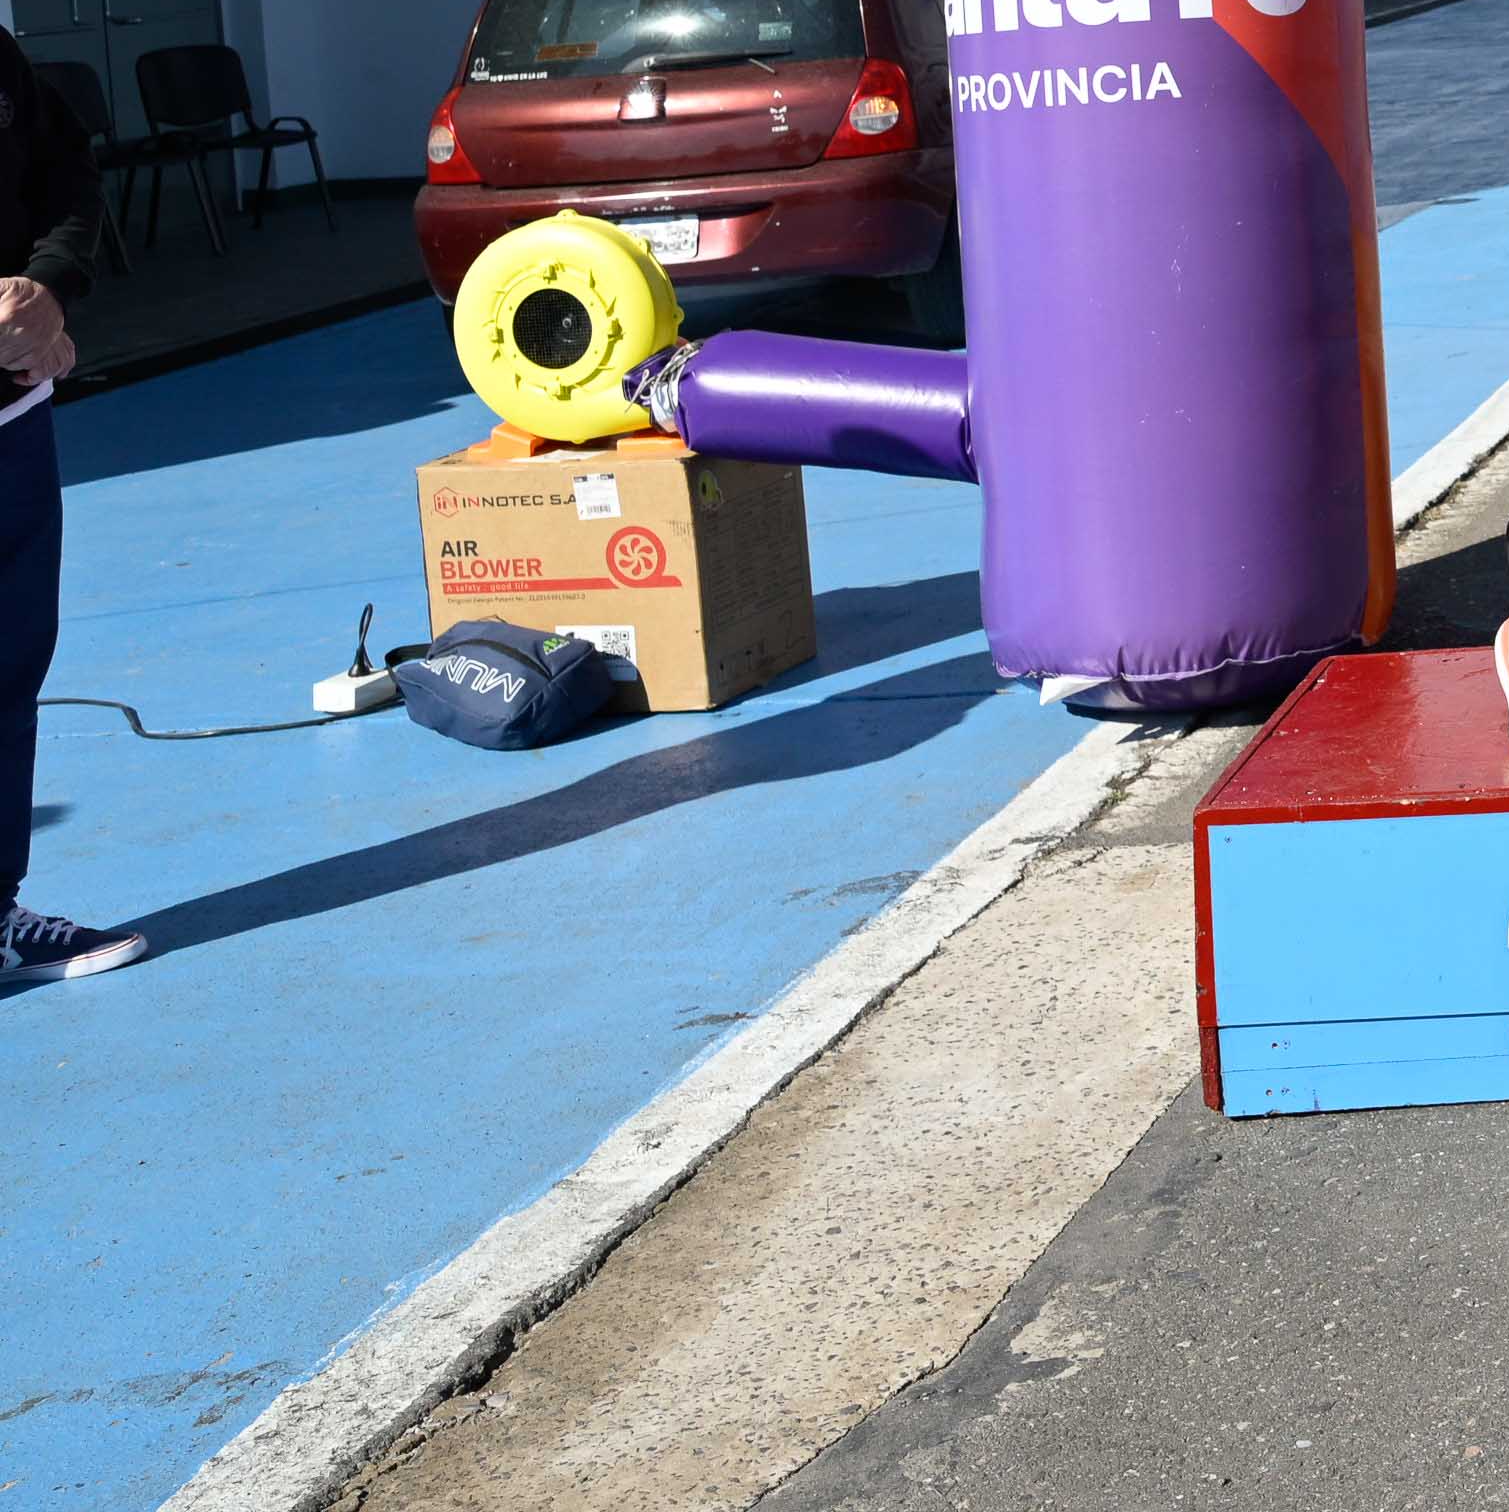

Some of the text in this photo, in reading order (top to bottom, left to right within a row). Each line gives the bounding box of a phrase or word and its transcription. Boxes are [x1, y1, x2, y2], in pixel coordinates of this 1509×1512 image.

[958, 62, 1181, 112] PROVINCIA
[462, 494, 544, 509] INNOTEC
[441, 540, 479, 558] AIR
[440, 558, 543, 580] BLOWER
